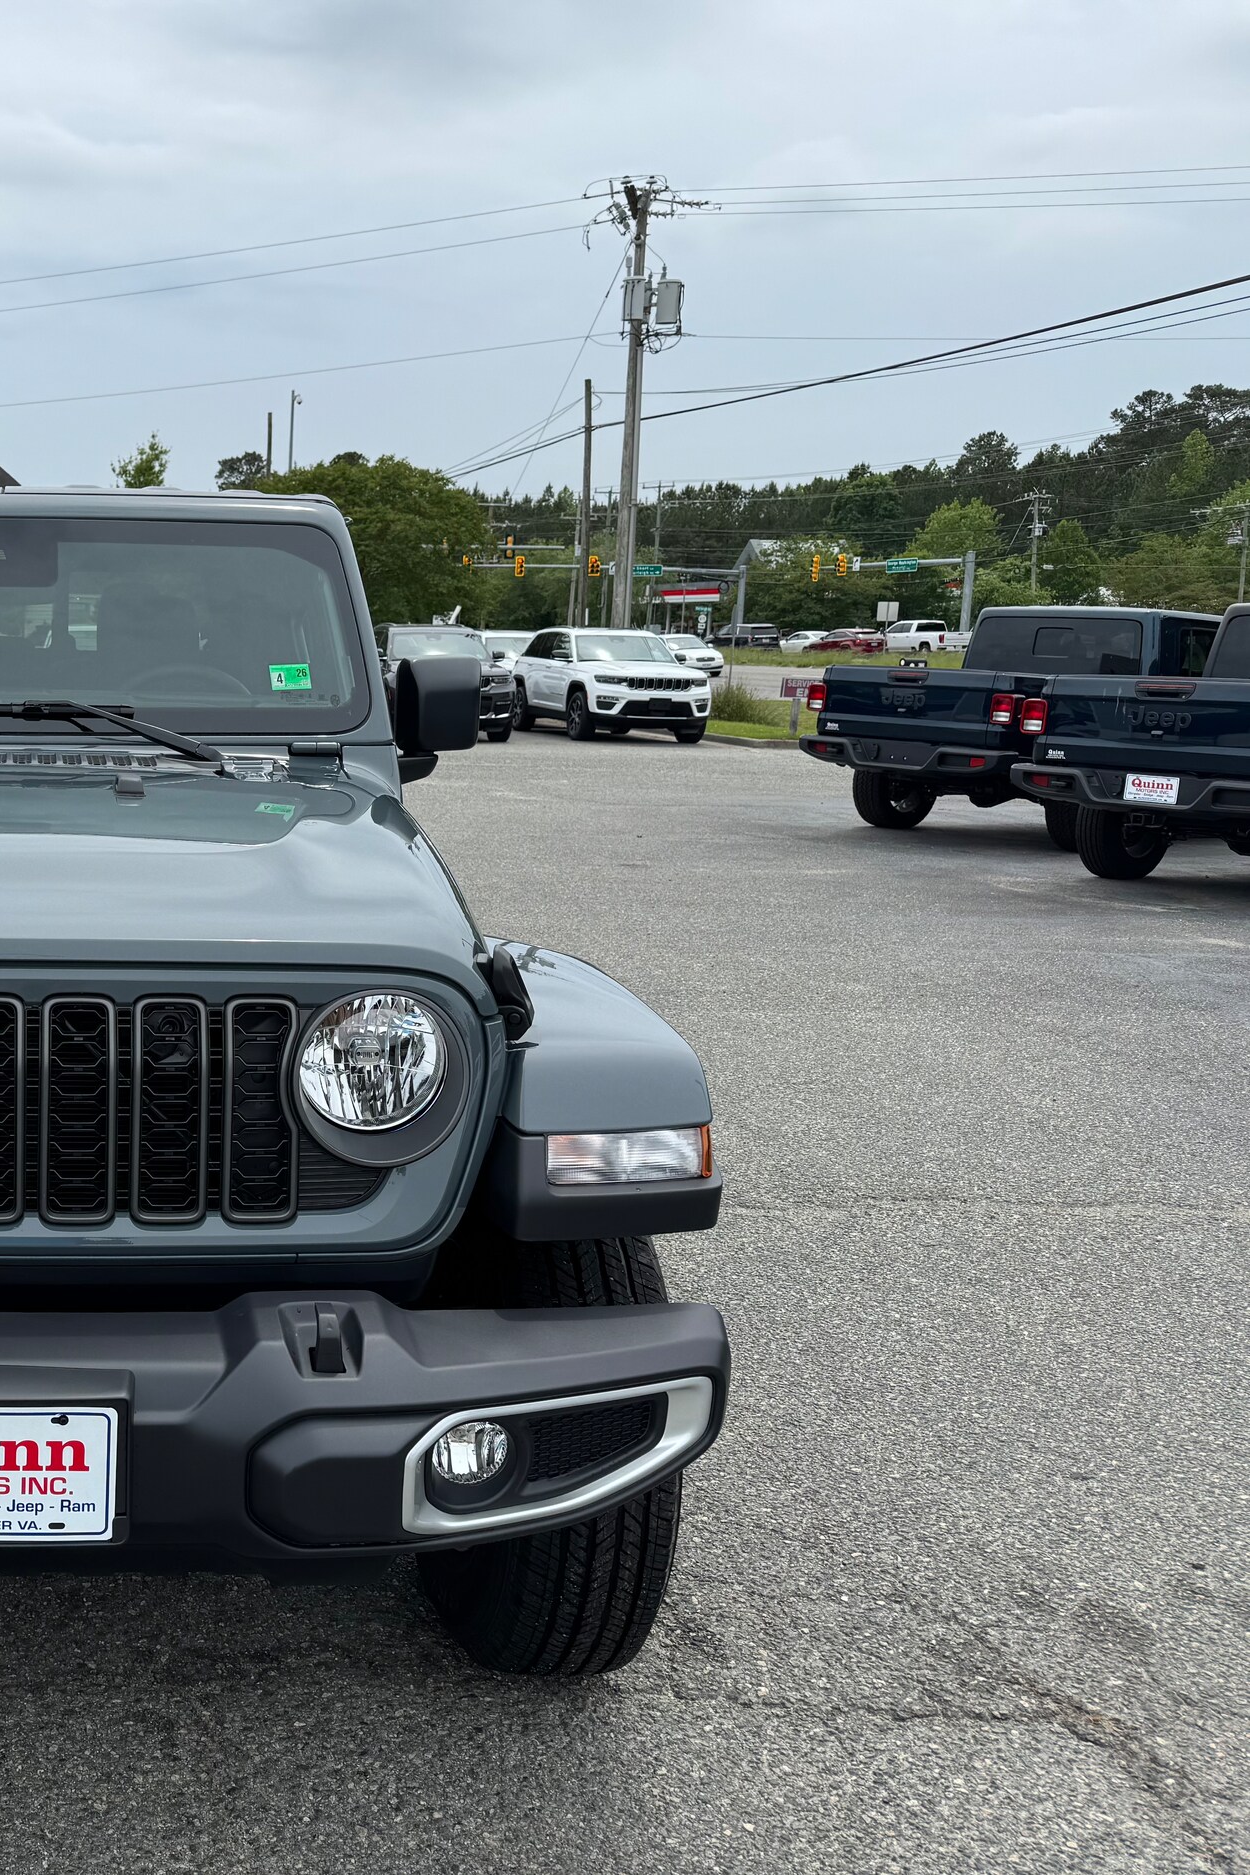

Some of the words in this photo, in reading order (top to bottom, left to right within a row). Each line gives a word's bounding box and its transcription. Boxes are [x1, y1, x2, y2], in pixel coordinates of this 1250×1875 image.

[276, 673, 284, 684] 4
[296, 668, 307, 678] 26
[881, 689, 926, 710] Jeep
[1128, 705, 1192, 732] Jeep
[1132, 777, 1173, 791] Quinn
[21, 1477, 74, 1496] INC.
[6, 1499, 44, 1516] Jeep
[60, 1499, 96, 1513] Ram
[17, 1520, 42, 1531] VA.
